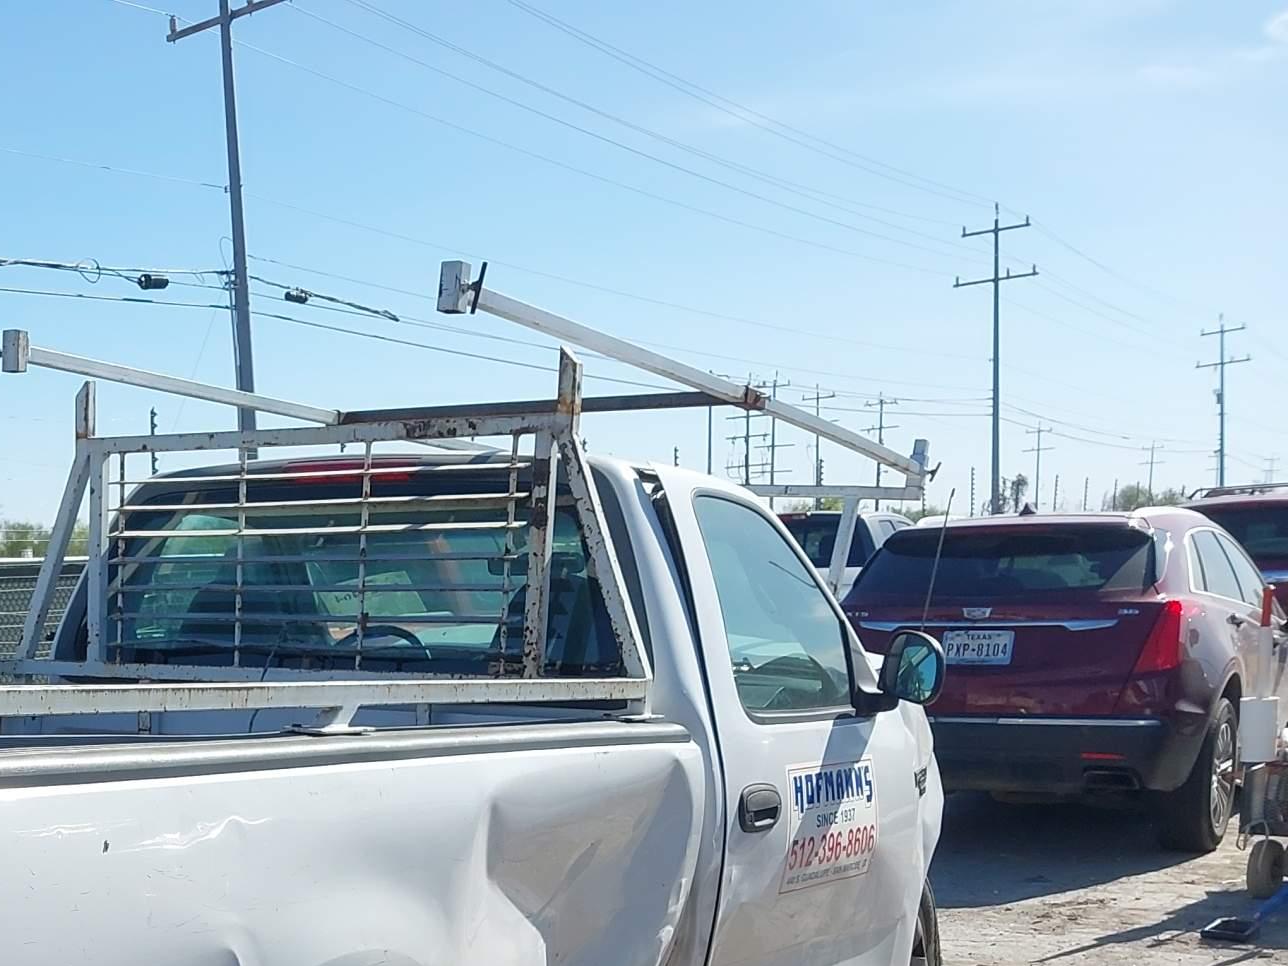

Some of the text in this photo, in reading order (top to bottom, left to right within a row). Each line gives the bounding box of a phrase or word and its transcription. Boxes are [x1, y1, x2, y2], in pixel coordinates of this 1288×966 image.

[946, 643, 1008, 657] PXP-8104
[816, 808, 856, 828] SINCE 1937
[788, 824, 876, 871] 512-396-8606
